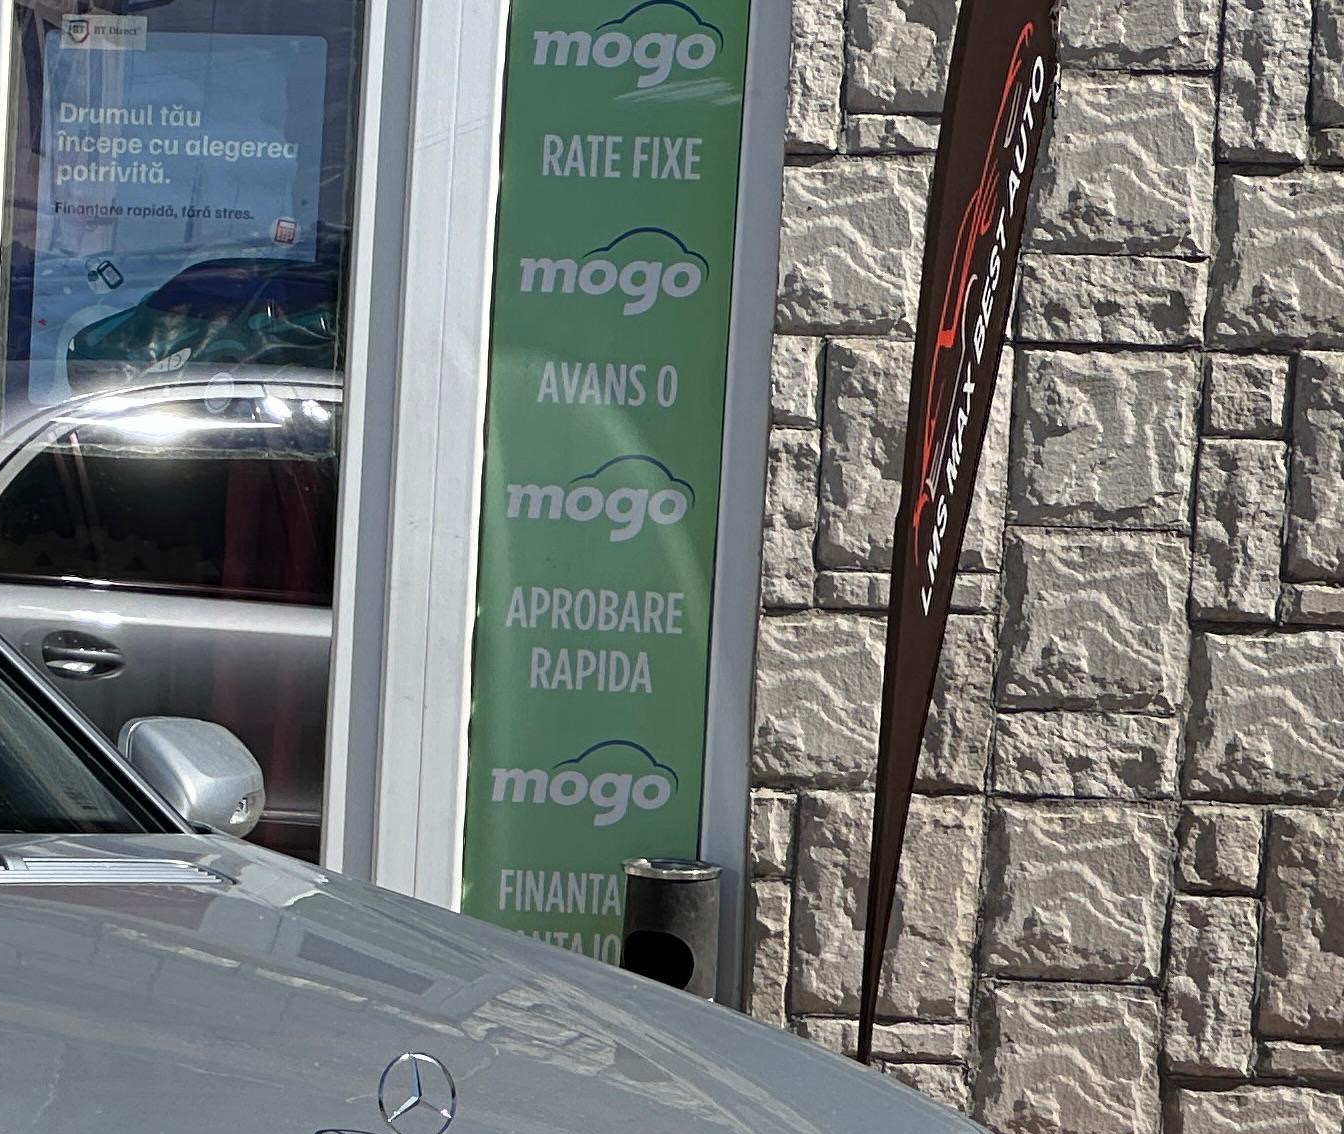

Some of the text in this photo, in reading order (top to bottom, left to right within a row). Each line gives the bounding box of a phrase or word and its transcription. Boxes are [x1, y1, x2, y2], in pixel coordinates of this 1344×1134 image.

[533, 30, 716, 88] mogo
[59, 102, 201, 127] Drumul tău
[56, 130, 299, 162] începe cu alegerea
[542, 134, 703, 180] RATE FIXE
[55, 160, 171, 185] potrivită.
[127, 203, 178, 219] rapidă,
[181, 205, 211, 218] fără
[214, 207, 254, 220] stres.
[519, 257, 701, 316] mogo
[921, 56, 1045, 616] LMS MAX BEST AUTO
[536, 360, 647, 407] AVANS
[506, 483, 688, 542] mogo
[505, 585, 685, 636] APROBARE
[529, 646, 653, 694] RAPIDA
[491, 767, 671, 827] mogo
[498, 868, 622, 916] FINANTA
